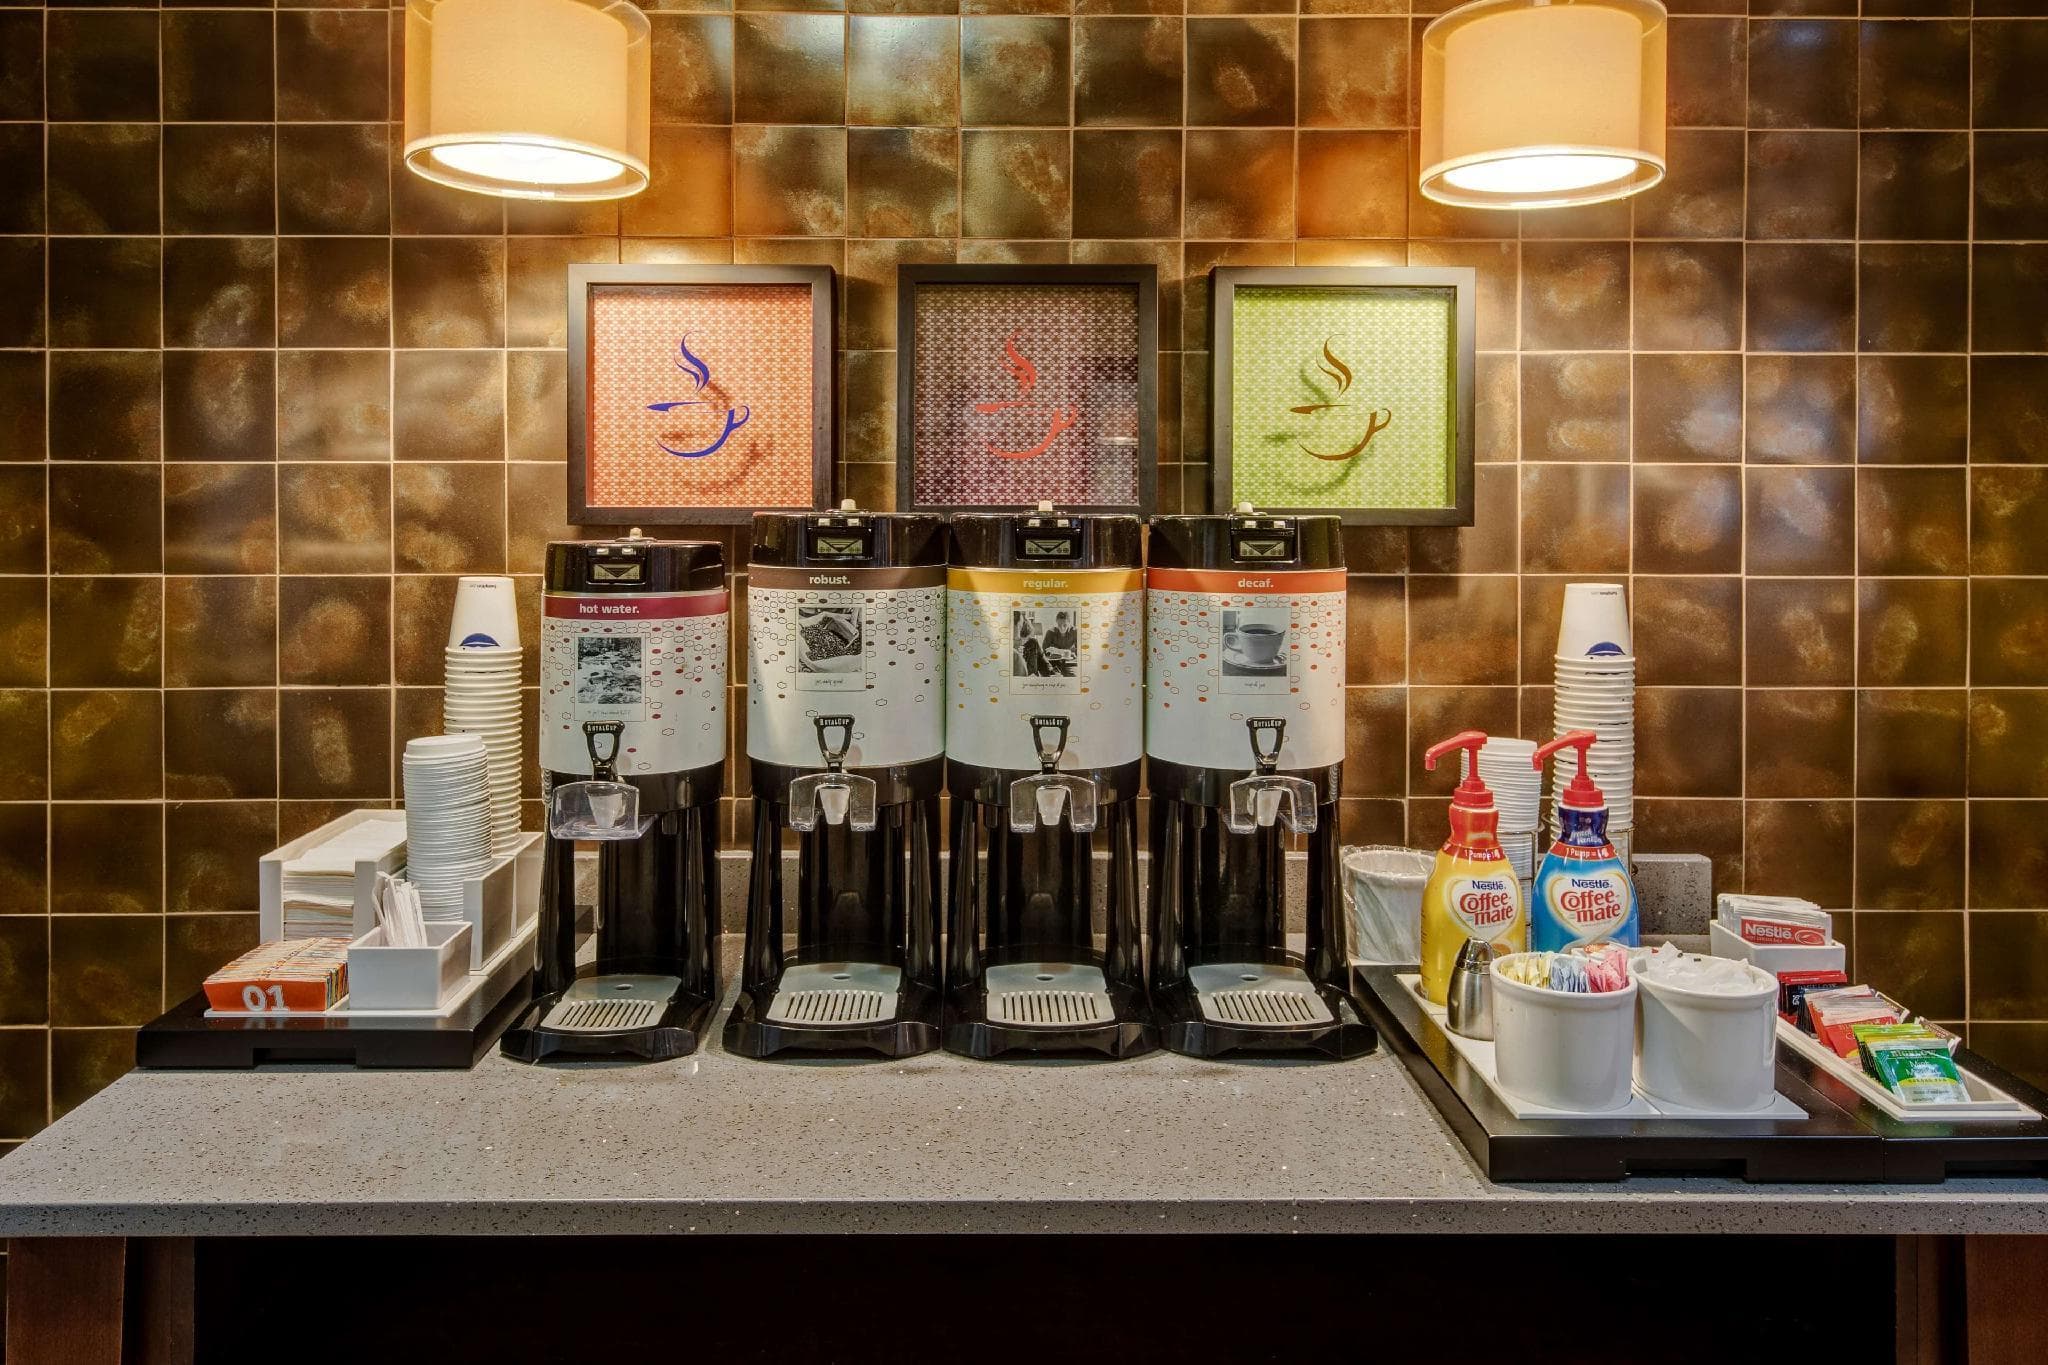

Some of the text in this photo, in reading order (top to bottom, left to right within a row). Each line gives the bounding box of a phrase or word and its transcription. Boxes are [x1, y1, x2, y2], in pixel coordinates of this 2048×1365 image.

[809, 574, 850, 585] robust.
[1023, 578, 1069, 591] regular.
[1238, 578, 1274, 588] decaf.
[579, 603, 640, 614] hot water.
[1570, 847, 1591, 859] Pump
[1474, 904, 1514, 926] mate
[1576, 902, 1621, 922] mate
[242, 984, 290, 1012] 01
